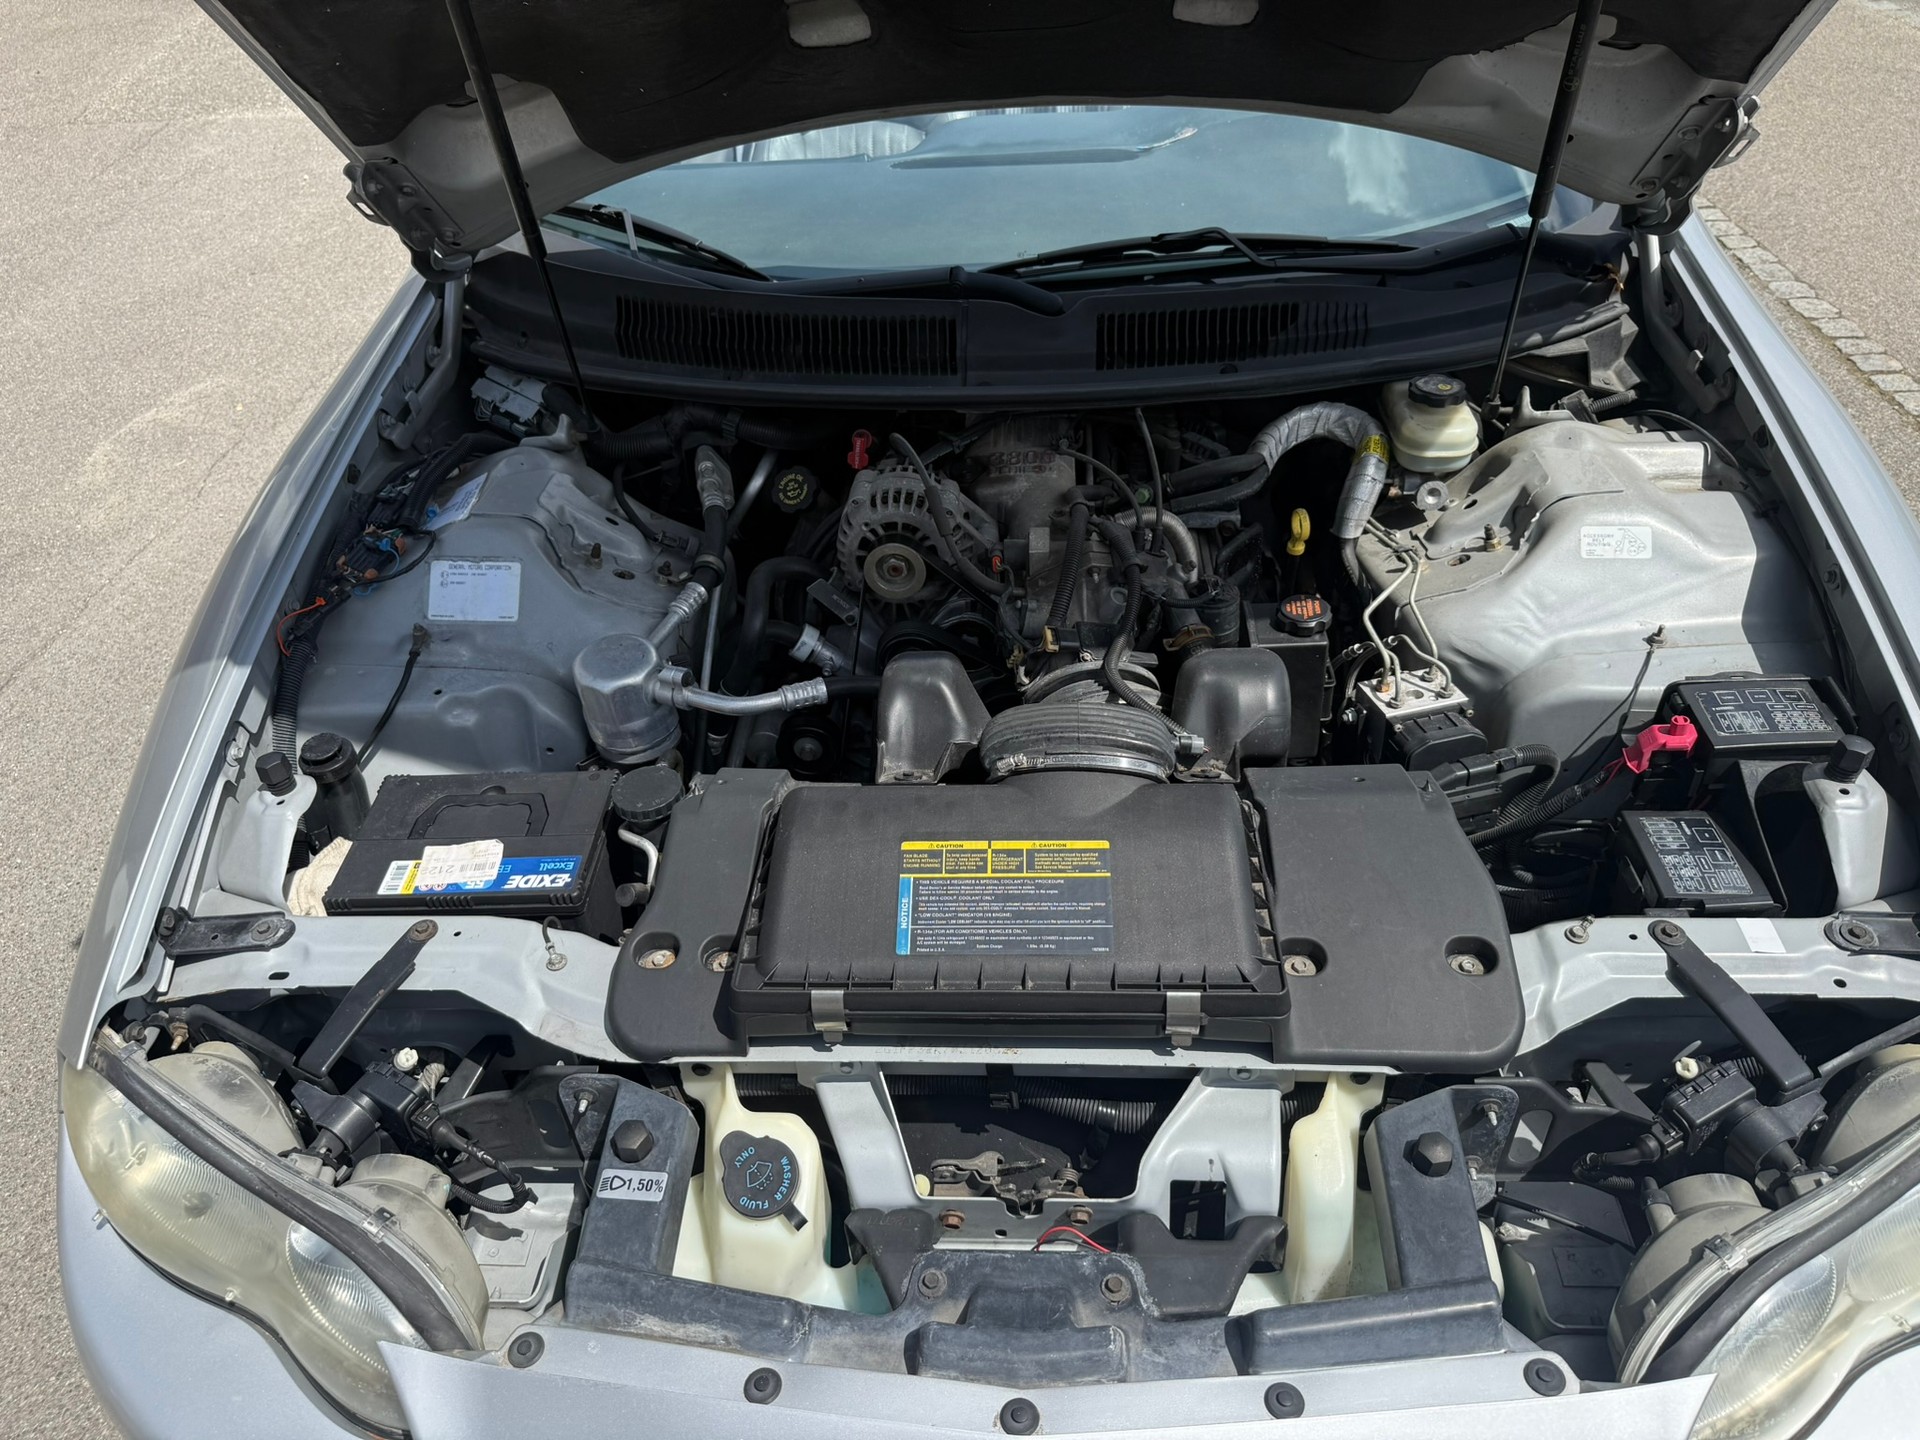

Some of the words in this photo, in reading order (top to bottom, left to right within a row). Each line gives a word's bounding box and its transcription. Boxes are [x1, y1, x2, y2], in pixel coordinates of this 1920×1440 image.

[990, 450, 1056, 466] 3800
[540, 862, 575, 871] Excell
[502, 874, 571, 889] EXIDE
[734, 1146, 755, 1168] ONLY
[627, 1177, 664, 1193] 1,50%
[774, 1156, 791, 1201] WASHER
[739, 1196, 769, 1210] FLUID
